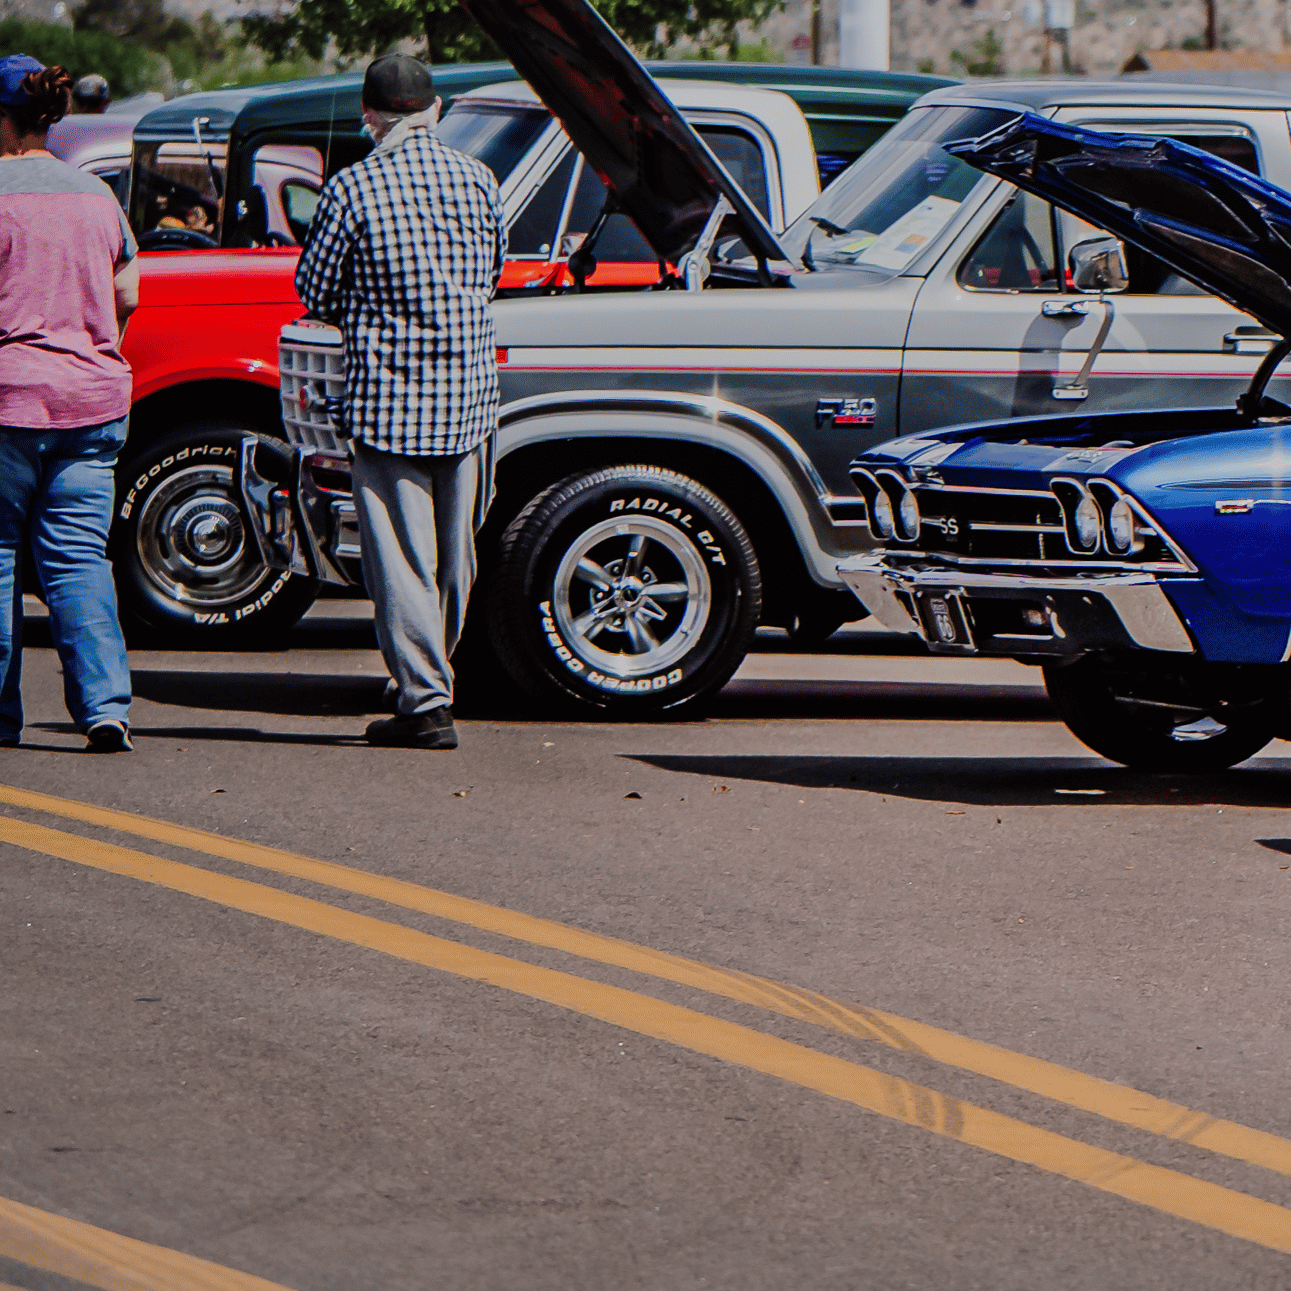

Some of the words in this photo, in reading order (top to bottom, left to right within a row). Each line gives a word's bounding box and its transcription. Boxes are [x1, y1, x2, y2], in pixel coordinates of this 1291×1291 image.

[120, 445, 238, 520] BFGoodrich
[610, 497, 693, 529] RADIAL
[697, 529, 727, 567] G/T
[940, 517, 959, 535] SS
[193, 612, 230, 625] T/A
[538, 600, 586, 664] COBRA
[586, 668, 683, 693] COOPER
